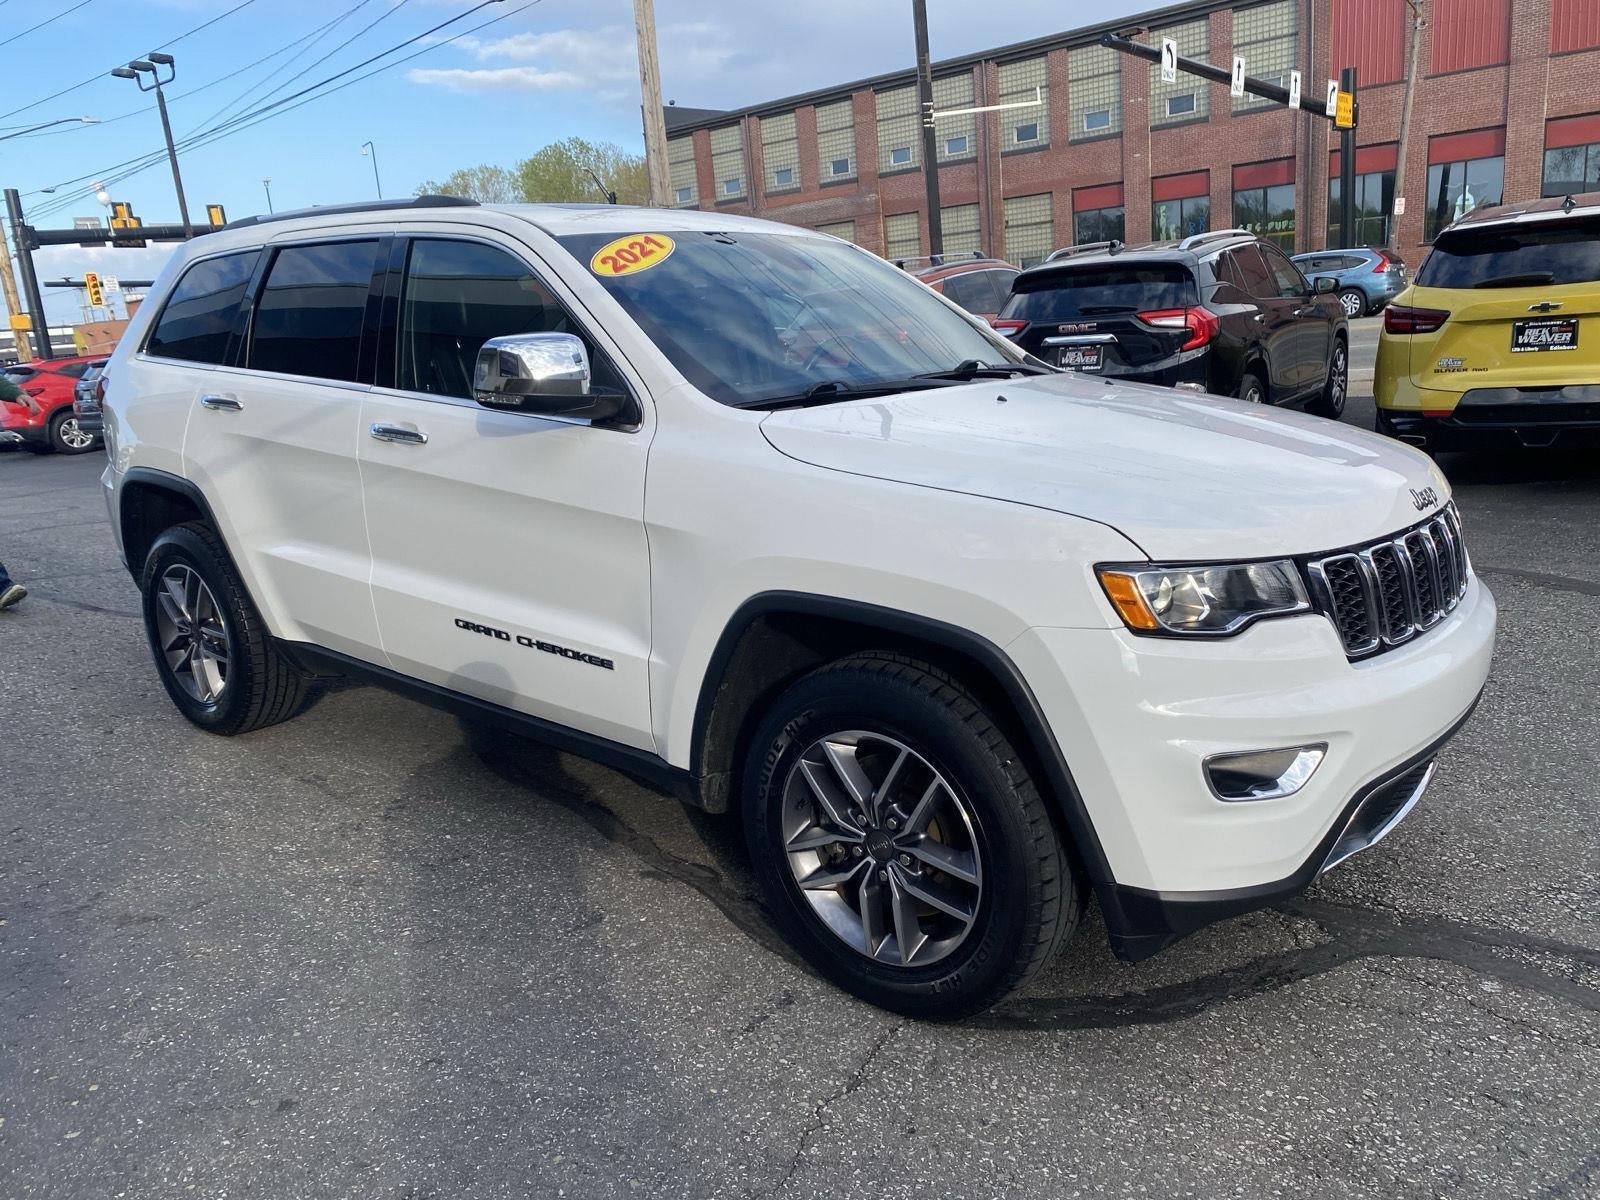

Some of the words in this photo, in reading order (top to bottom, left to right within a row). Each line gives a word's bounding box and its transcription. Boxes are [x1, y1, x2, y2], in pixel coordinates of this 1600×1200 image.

[1162, 68, 1175, 79] ONLY
[600, 236, 664, 273] 2021
[1058, 323, 1097, 333] GMC
[1524, 327, 1550, 336] RICK
[1518, 332, 1573, 344] WEAVER
[1061, 355, 1098, 364] WEAVER
[1408, 486, 1438, 511] Jeep
[454, 618, 511, 642] GRAND
[516, 635, 615, 670] CHEROKEE
